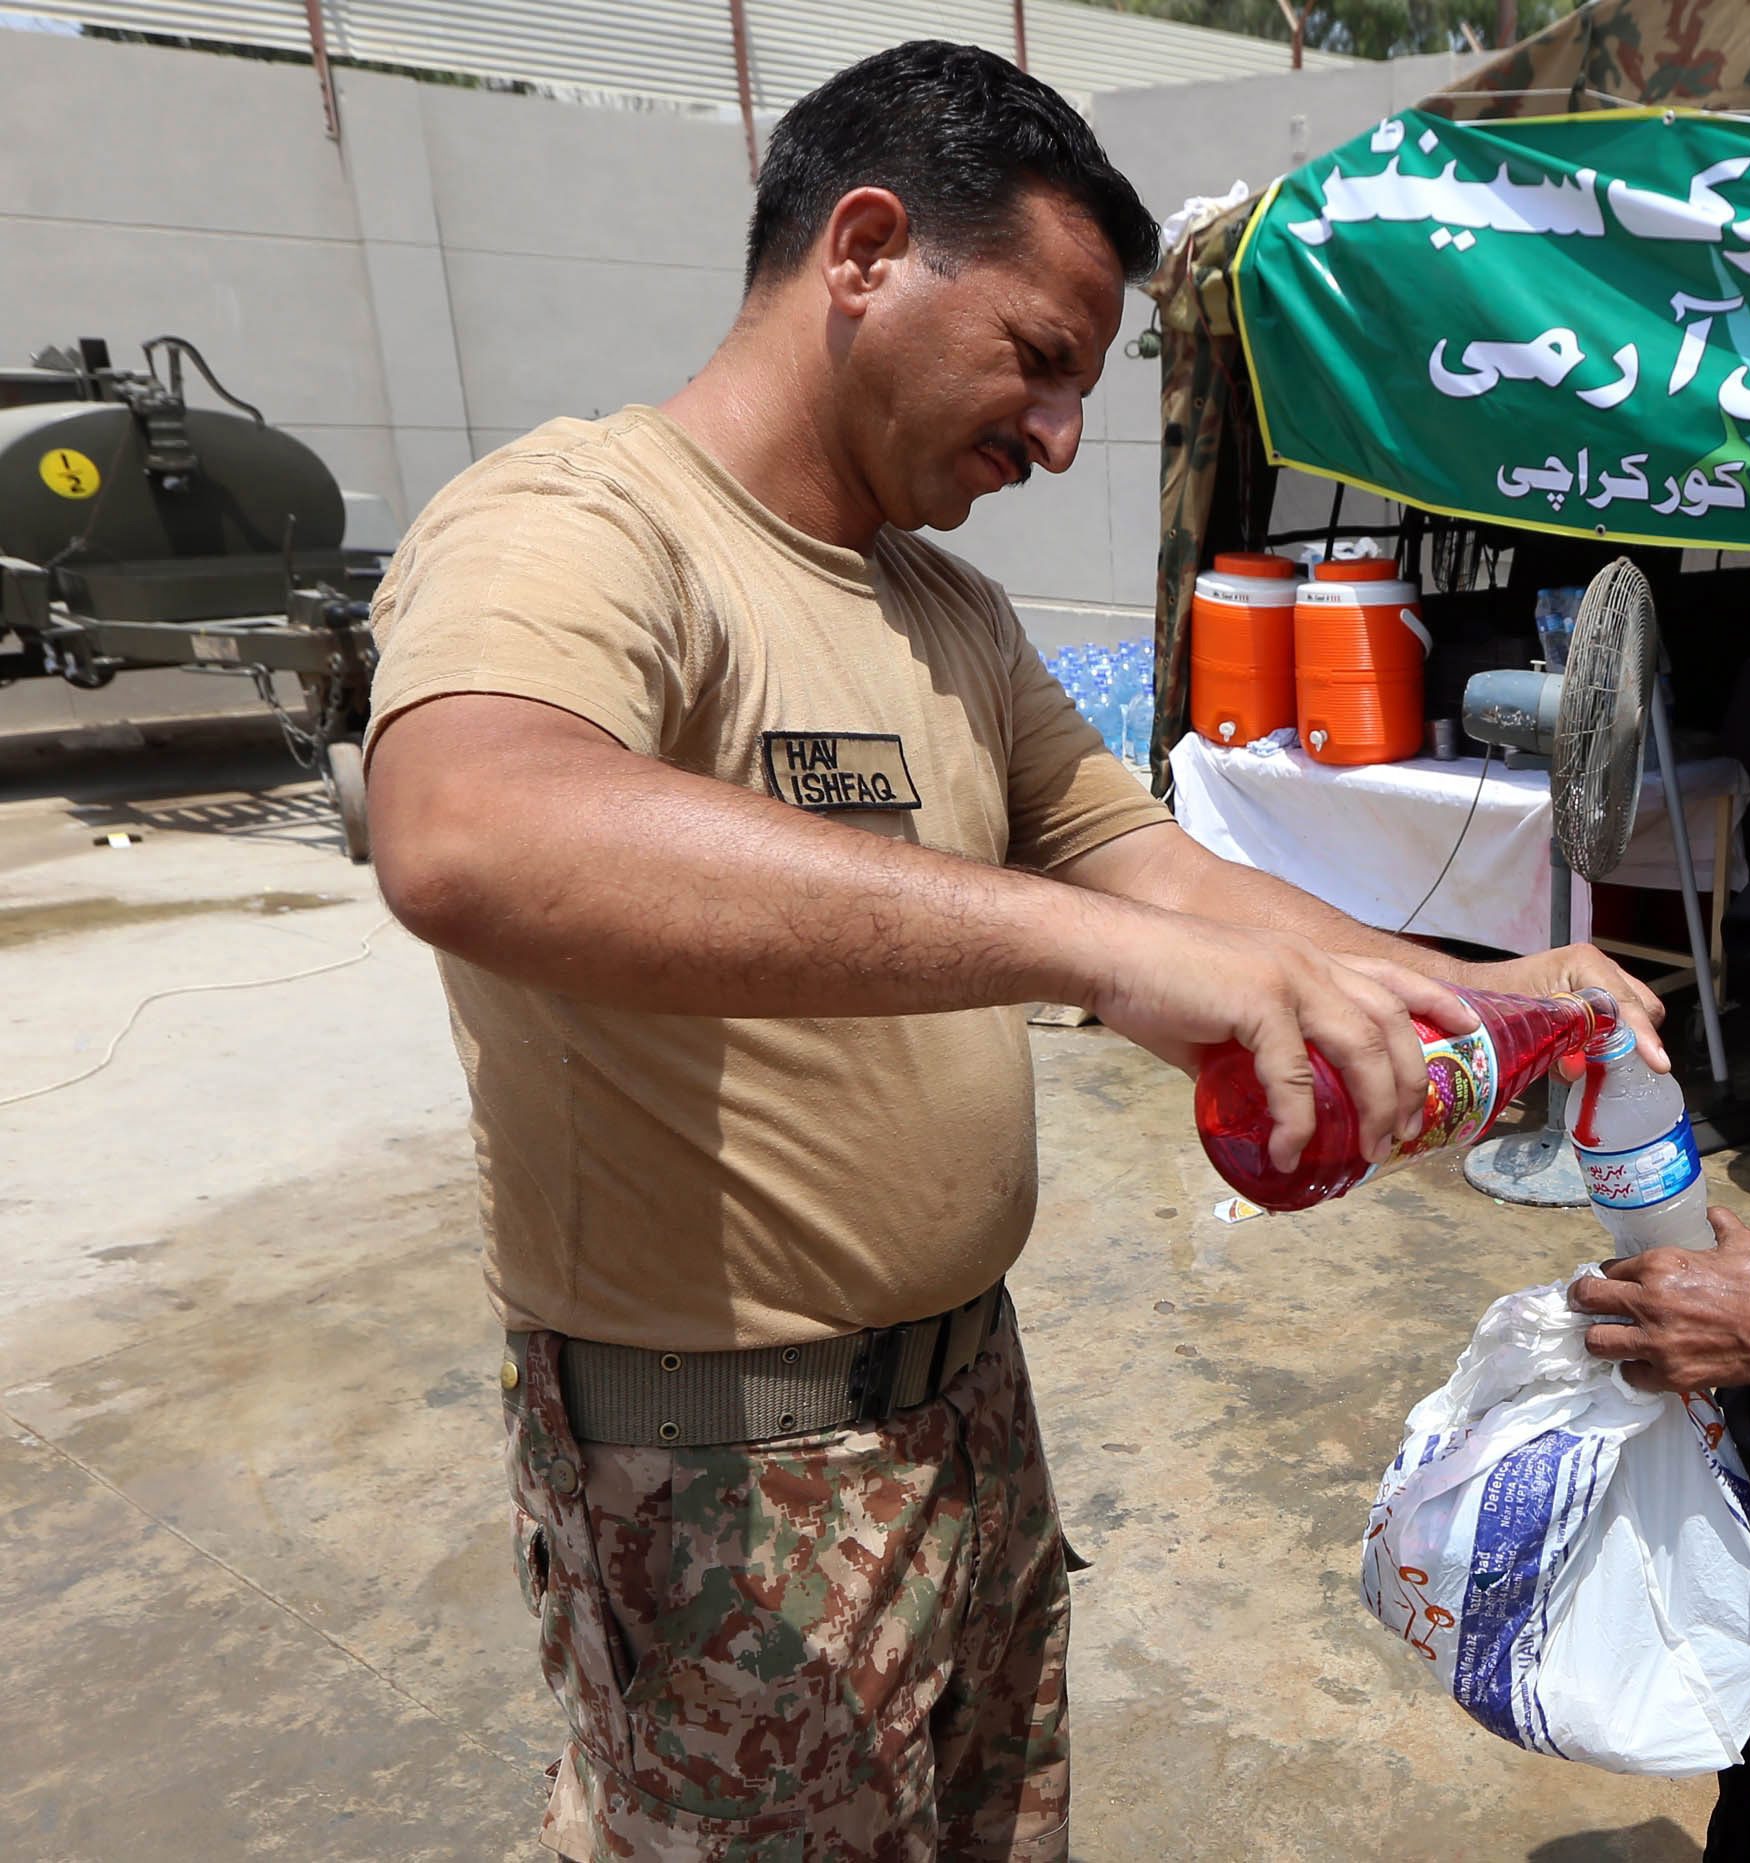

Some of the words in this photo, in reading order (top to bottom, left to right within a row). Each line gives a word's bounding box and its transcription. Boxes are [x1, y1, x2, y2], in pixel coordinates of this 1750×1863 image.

[1287, 116, 1606, 251] سینٹر
[1496, 446, 1649, 512] کراچی
[786, 739, 838, 771] HAV
[790, 772, 897, 804] ISHFAQ
[1483, 1461, 1512, 1512] Defence
[1517, 1484, 1528, 1504] KPT
[1467, 1551, 1491, 1615] Nazimbad
